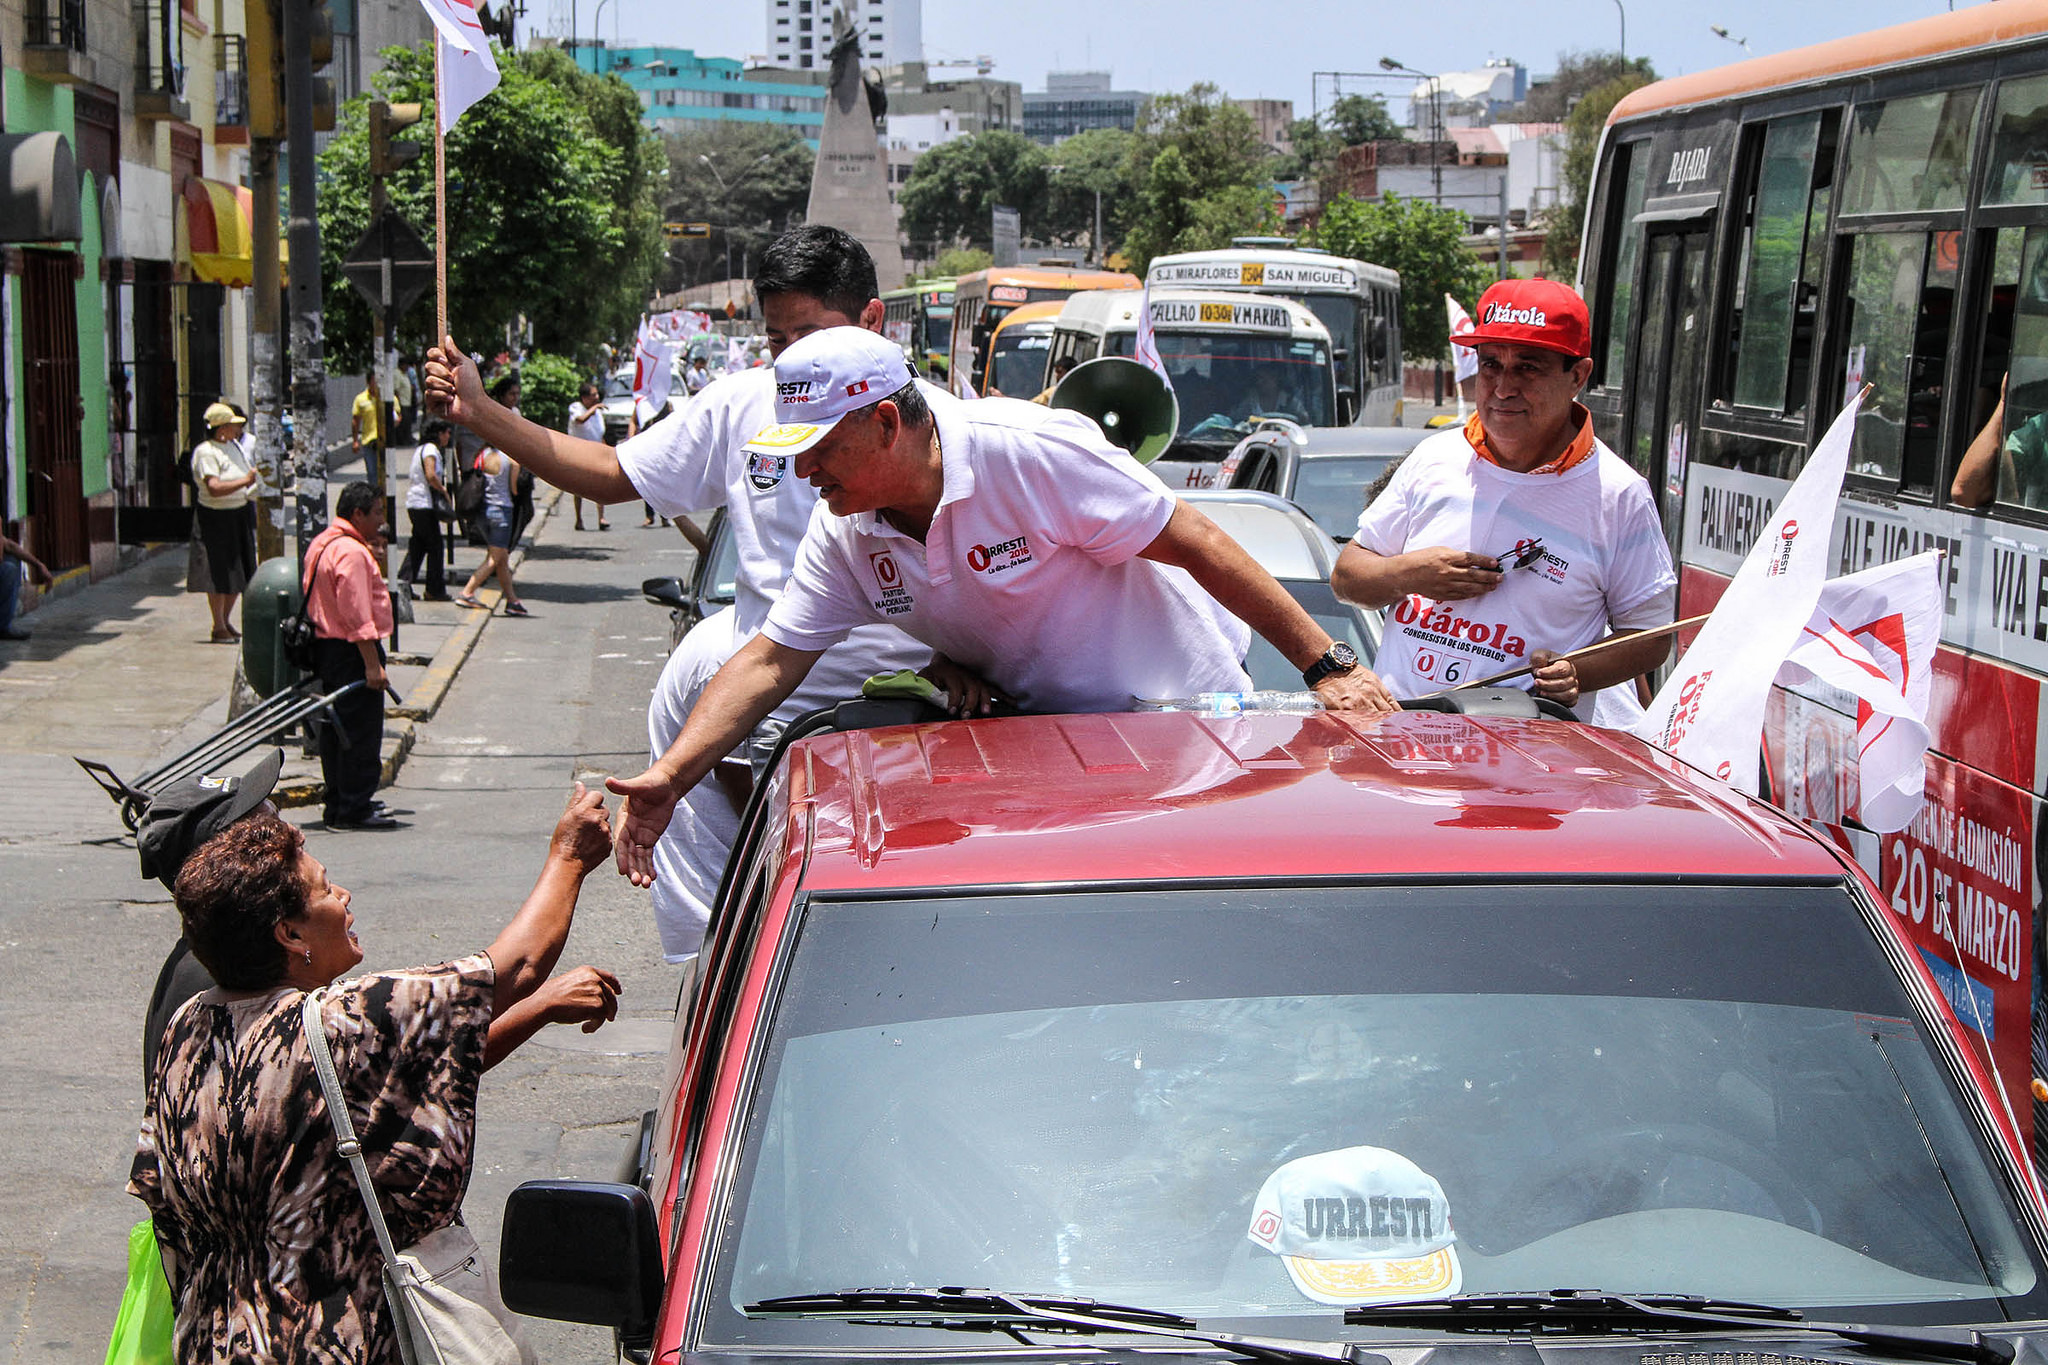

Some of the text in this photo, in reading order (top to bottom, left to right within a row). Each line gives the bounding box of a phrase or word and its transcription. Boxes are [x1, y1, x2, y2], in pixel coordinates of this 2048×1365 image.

[1667, 146, 1711, 191] BAJADA
[1176, 267, 1239, 280] MIRAFLORES
[1268, 268, 1293, 281] SAN
[1297, 271, 1346, 285] MIGUEL
[1151, 304, 1196, 321] CALLAO
[1484, 301, 1546, 327] Otárola
[783, 395, 810, 404] 2016
[1009, 547, 1029, 559] 2016
[1547, 565, 1566, 579] 2016
[1992, 547, 2027, 636] VIA
[1395, 597, 1526, 657] Otárola
[1403, 628, 1506, 663] CONGRESISTA DE LOS PUEBLOS
[1445, 662, 1460, 682] 6
[1957, 816, 2022, 893] ADMISIÓN
[1892, 839, 2021, 982] 20 DE MARZO
[1304, 1197, 1433, 1239] URRESTI
